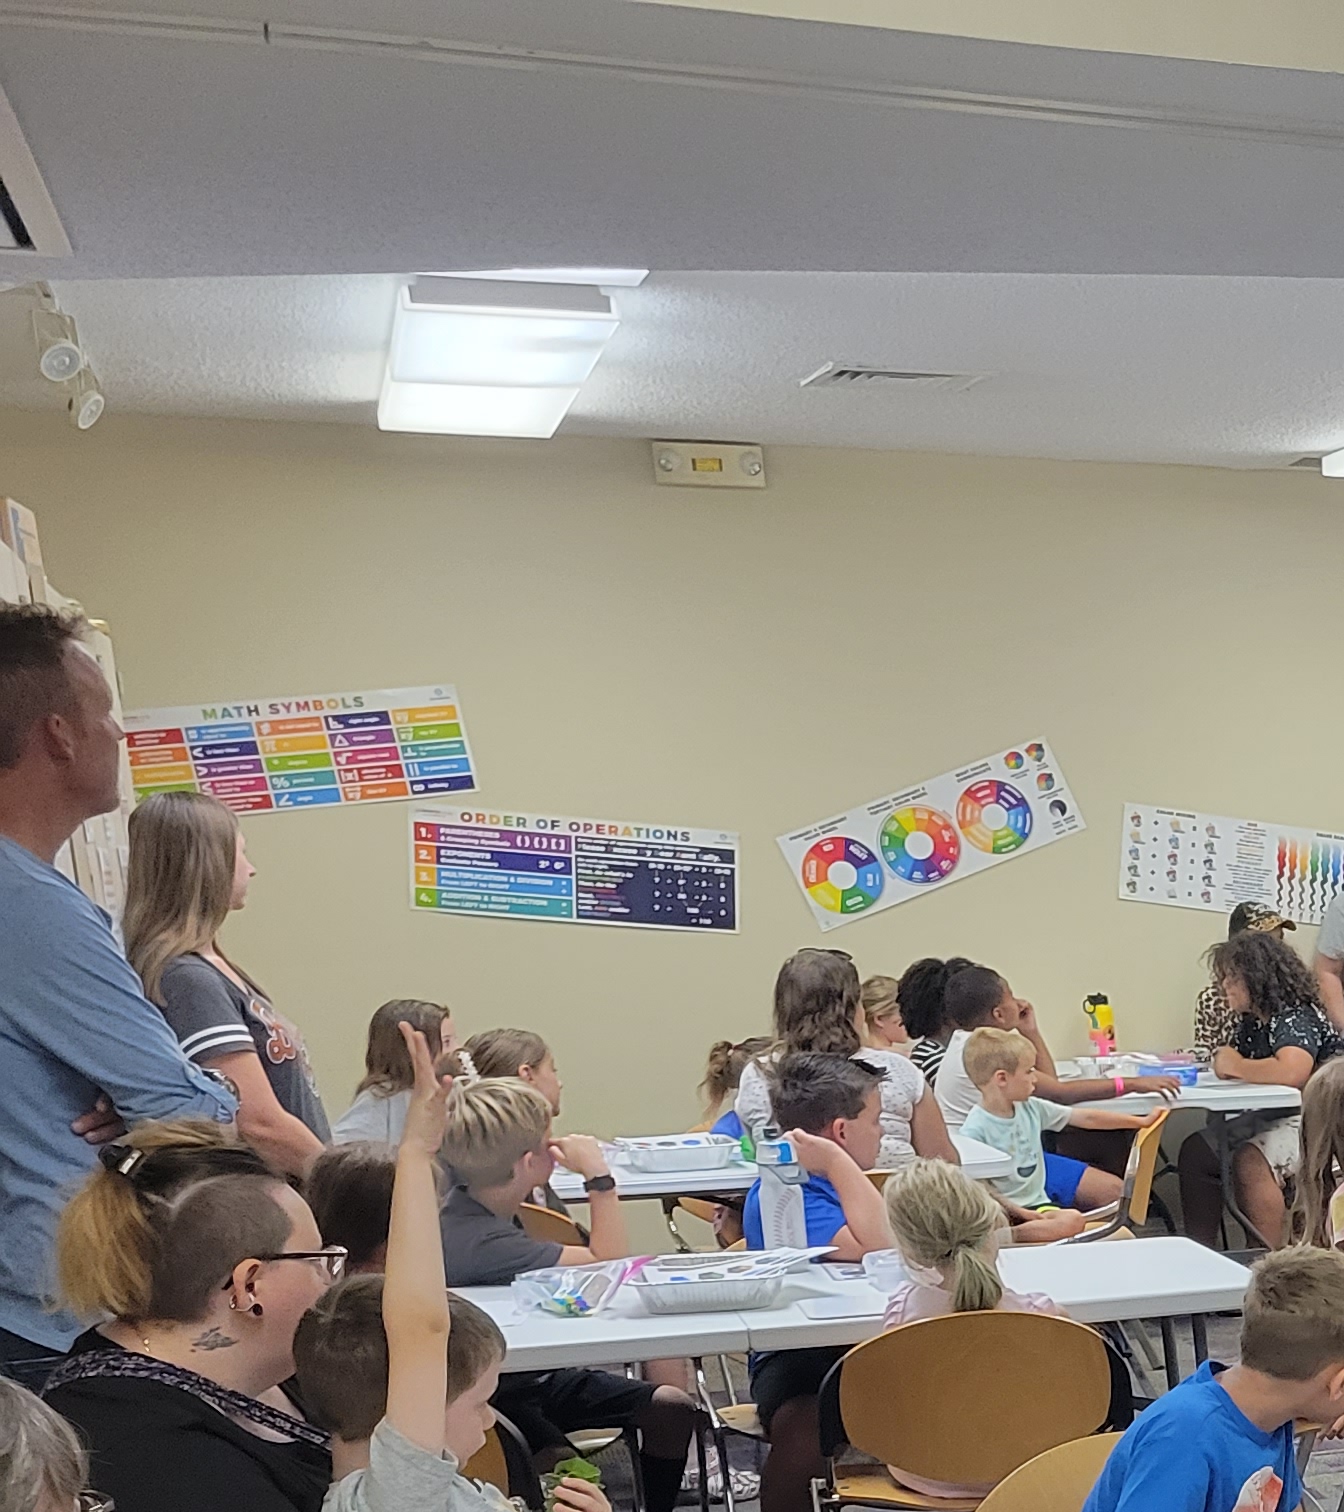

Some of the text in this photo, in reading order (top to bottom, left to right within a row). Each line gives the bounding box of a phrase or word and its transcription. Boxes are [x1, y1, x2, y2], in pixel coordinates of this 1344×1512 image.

[202, 696, 364, 720] MATH SYMBOLS
[460, 812, 691, 842] ORDER OF OPERATIONS
